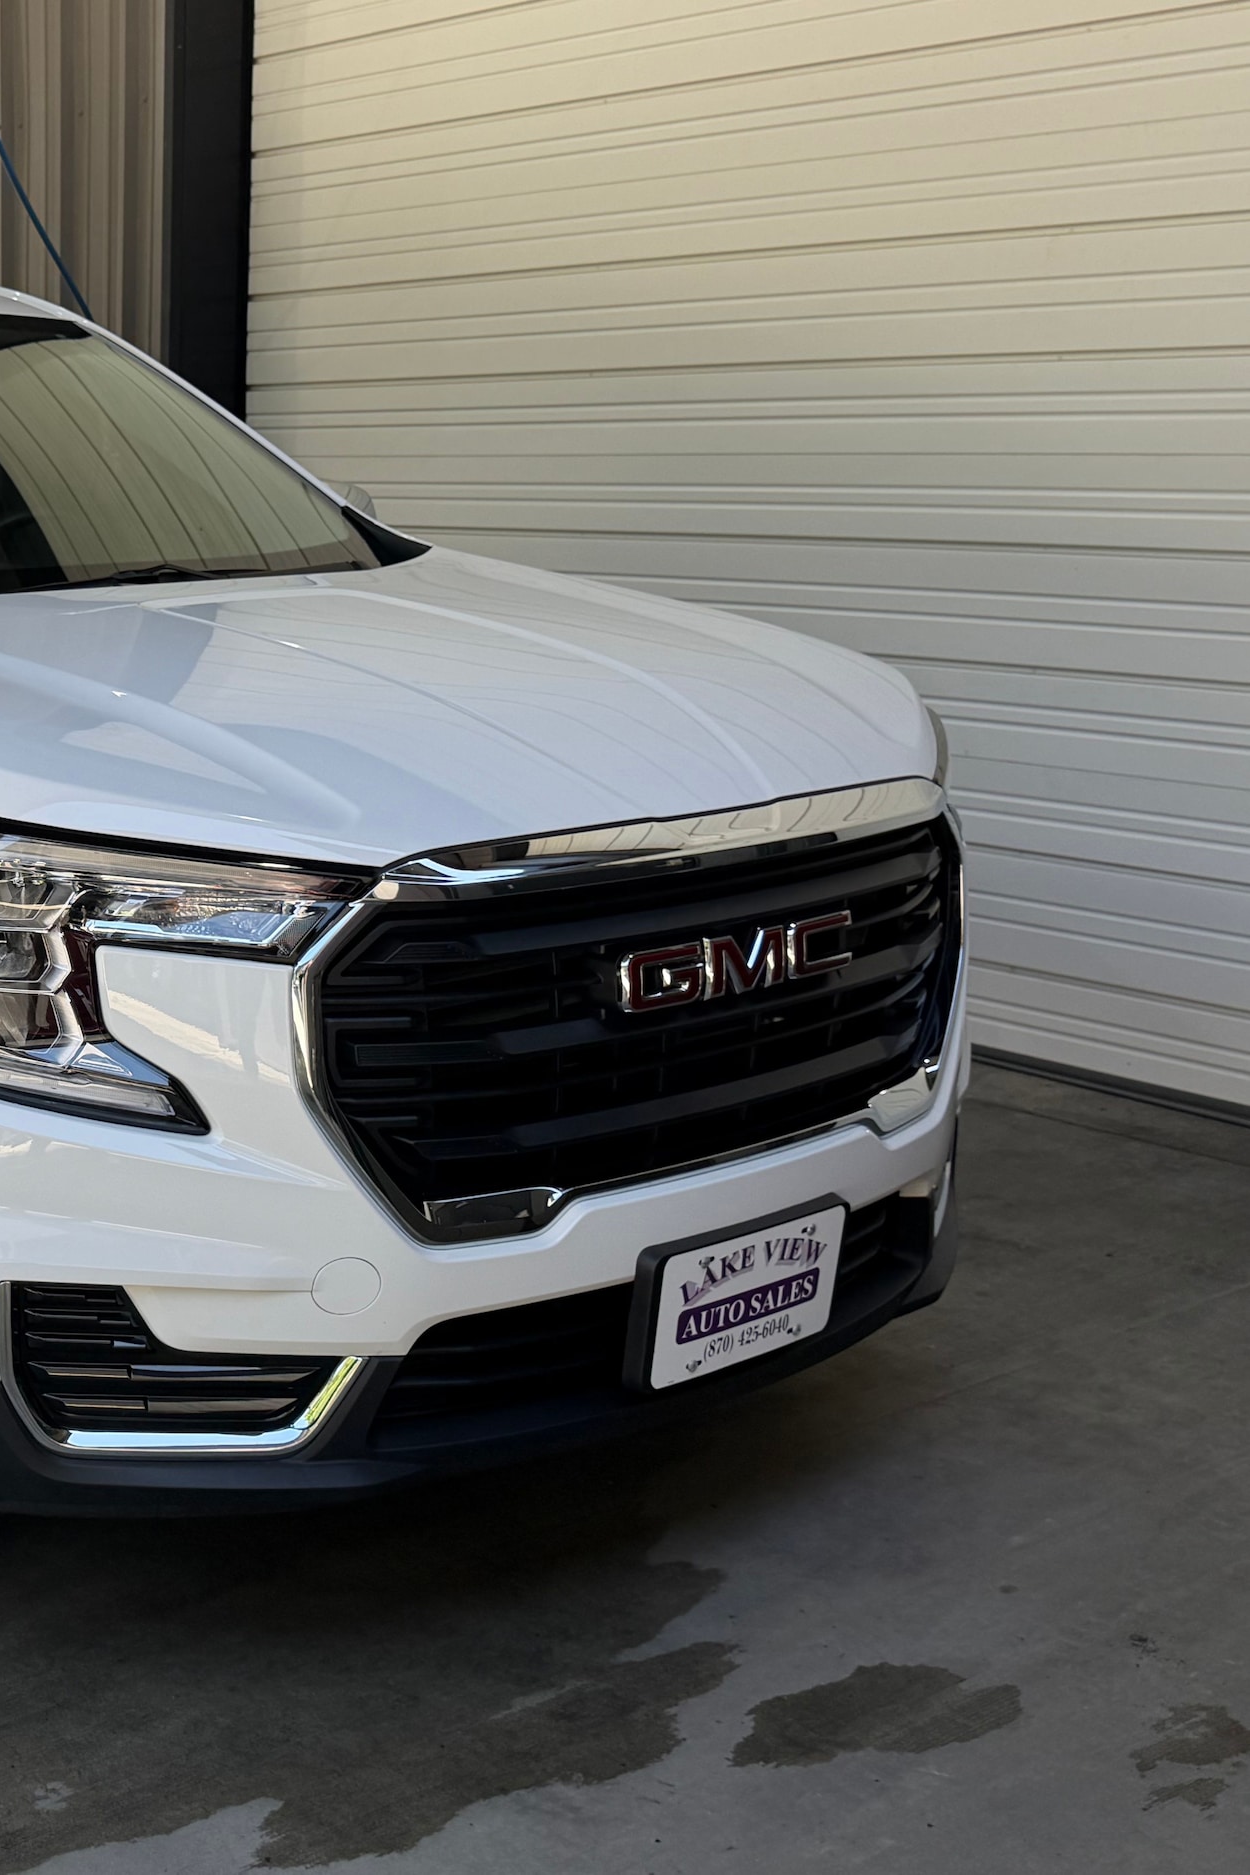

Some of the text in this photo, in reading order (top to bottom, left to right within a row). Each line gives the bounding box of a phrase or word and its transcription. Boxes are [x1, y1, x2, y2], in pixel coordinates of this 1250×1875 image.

[617, 910, 852, 1013] GMC
[679, 1237, 828, 1306] LAKE VIEW
[681, 1275, 814, 1339] AUTO SALES
[703, 1314, 790, 1362] (870) 425-6040
